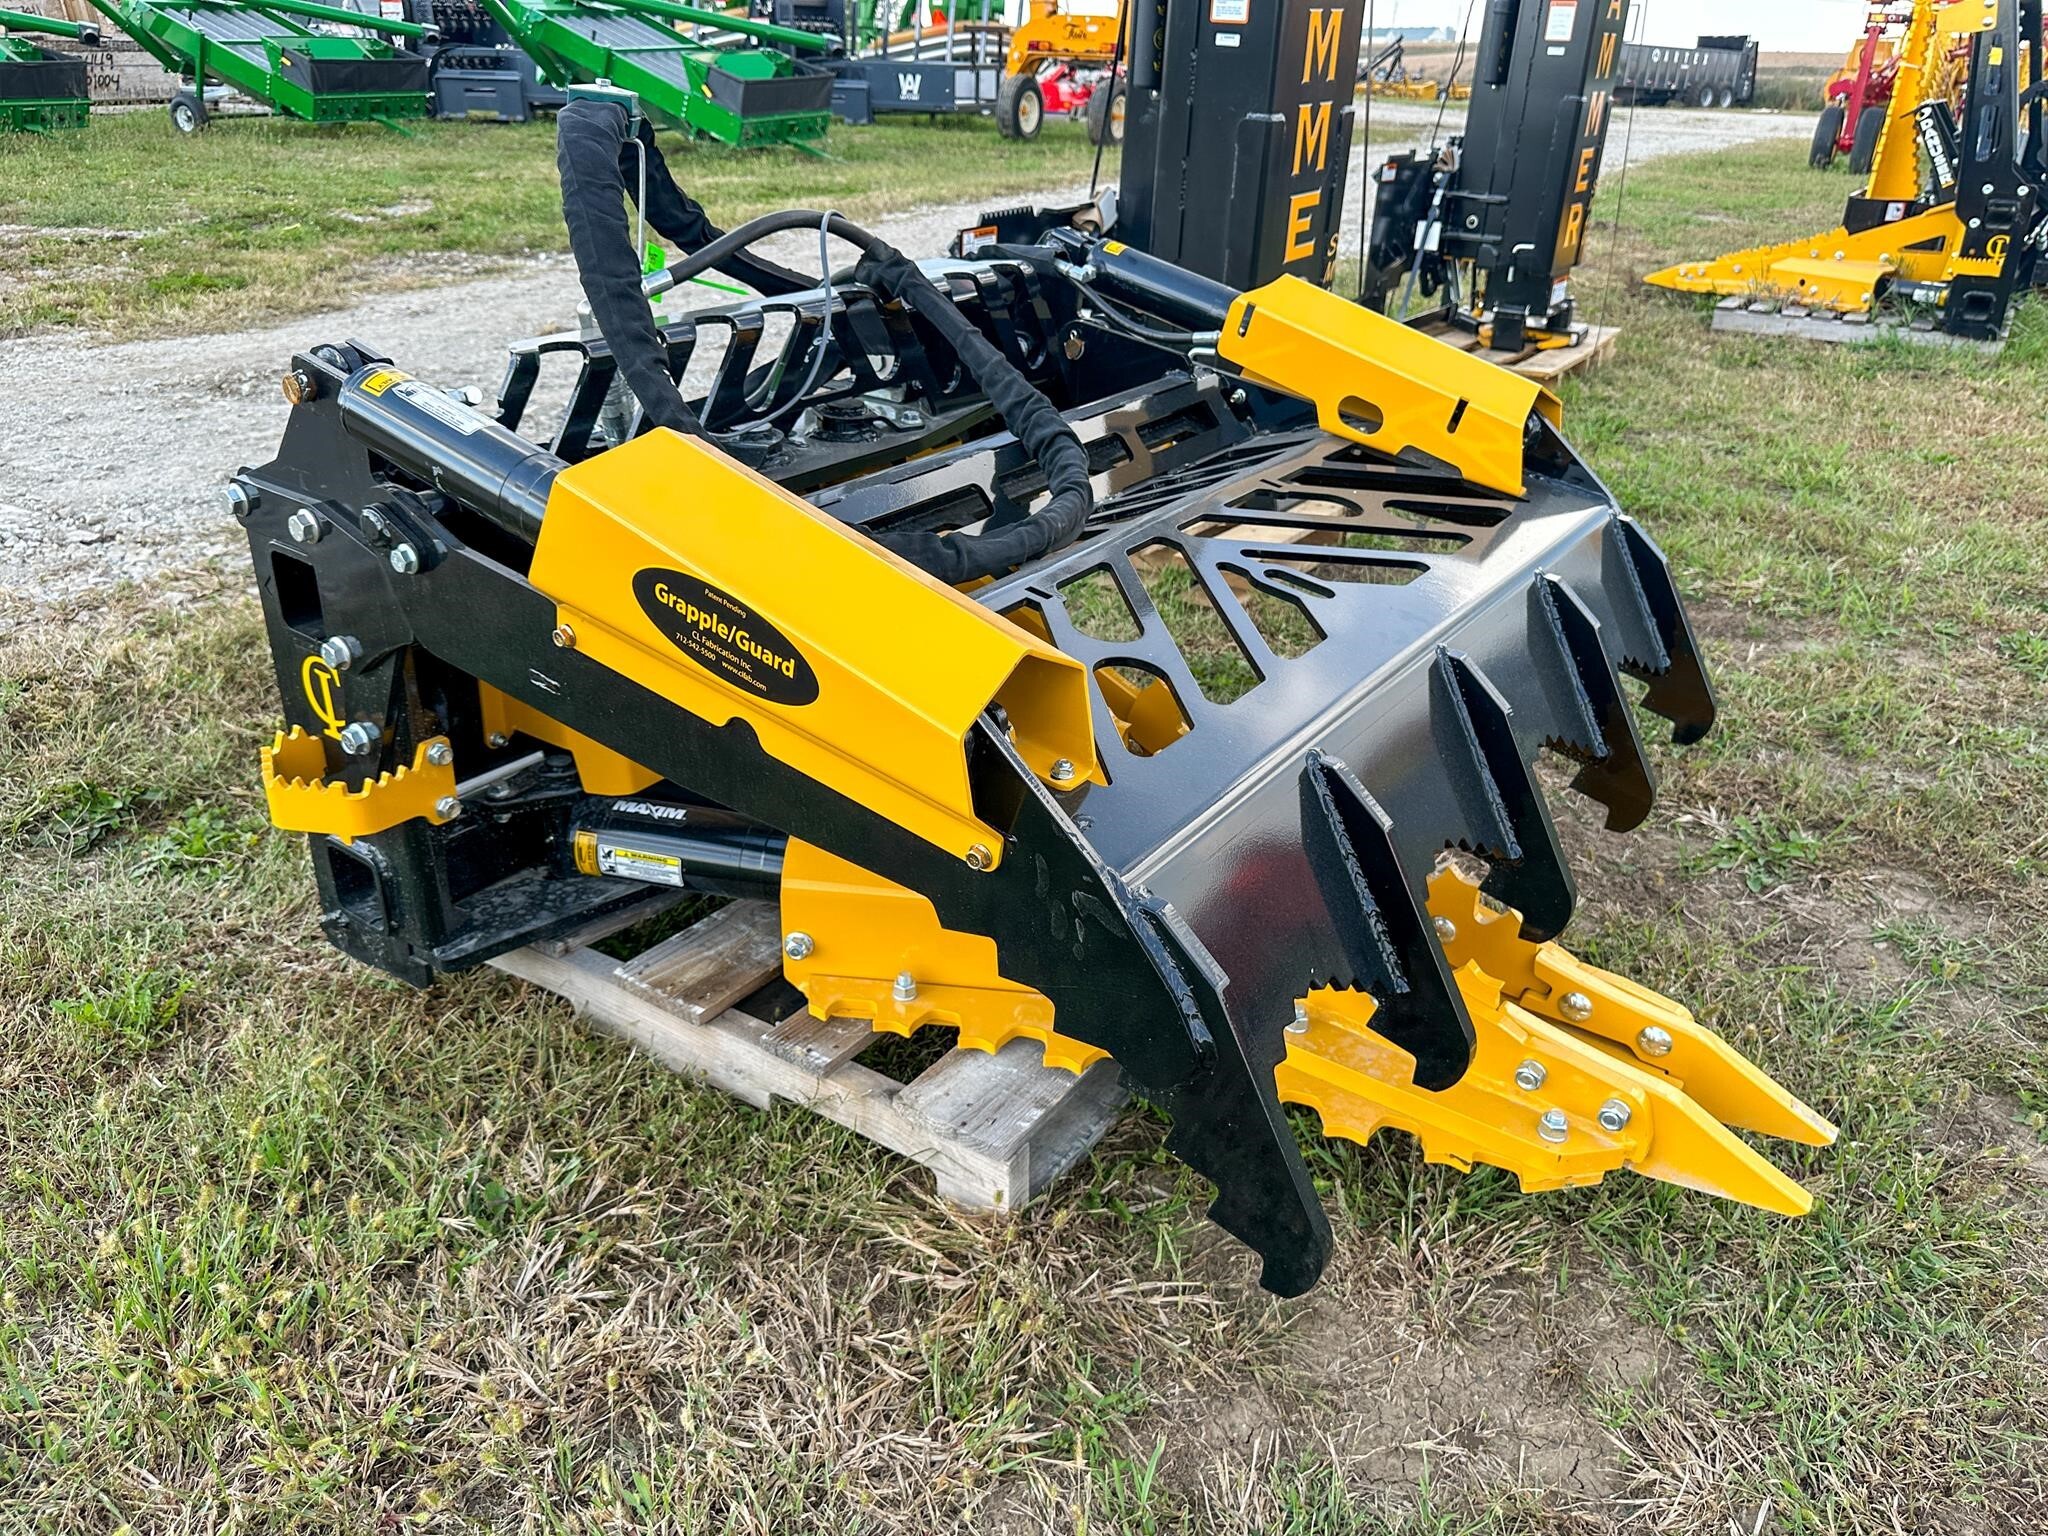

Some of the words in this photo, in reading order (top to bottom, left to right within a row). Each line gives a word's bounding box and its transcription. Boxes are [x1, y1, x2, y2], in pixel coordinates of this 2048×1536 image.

[704, 588, 723, 605] Patent
[723, 599, 747, 619] Pending
[654, 582, 796, 680] Grapple/Guard
[692, 630, 701, 642] CL
[701, 636, 740, 665] Fabrication
[740, 660, 753, 673] Inc.
[675, 632, 716, 661] 712-542-5500
[721, 661, 767, 692] www.clfab.com
[631, 853, 668, 863] WARNING
